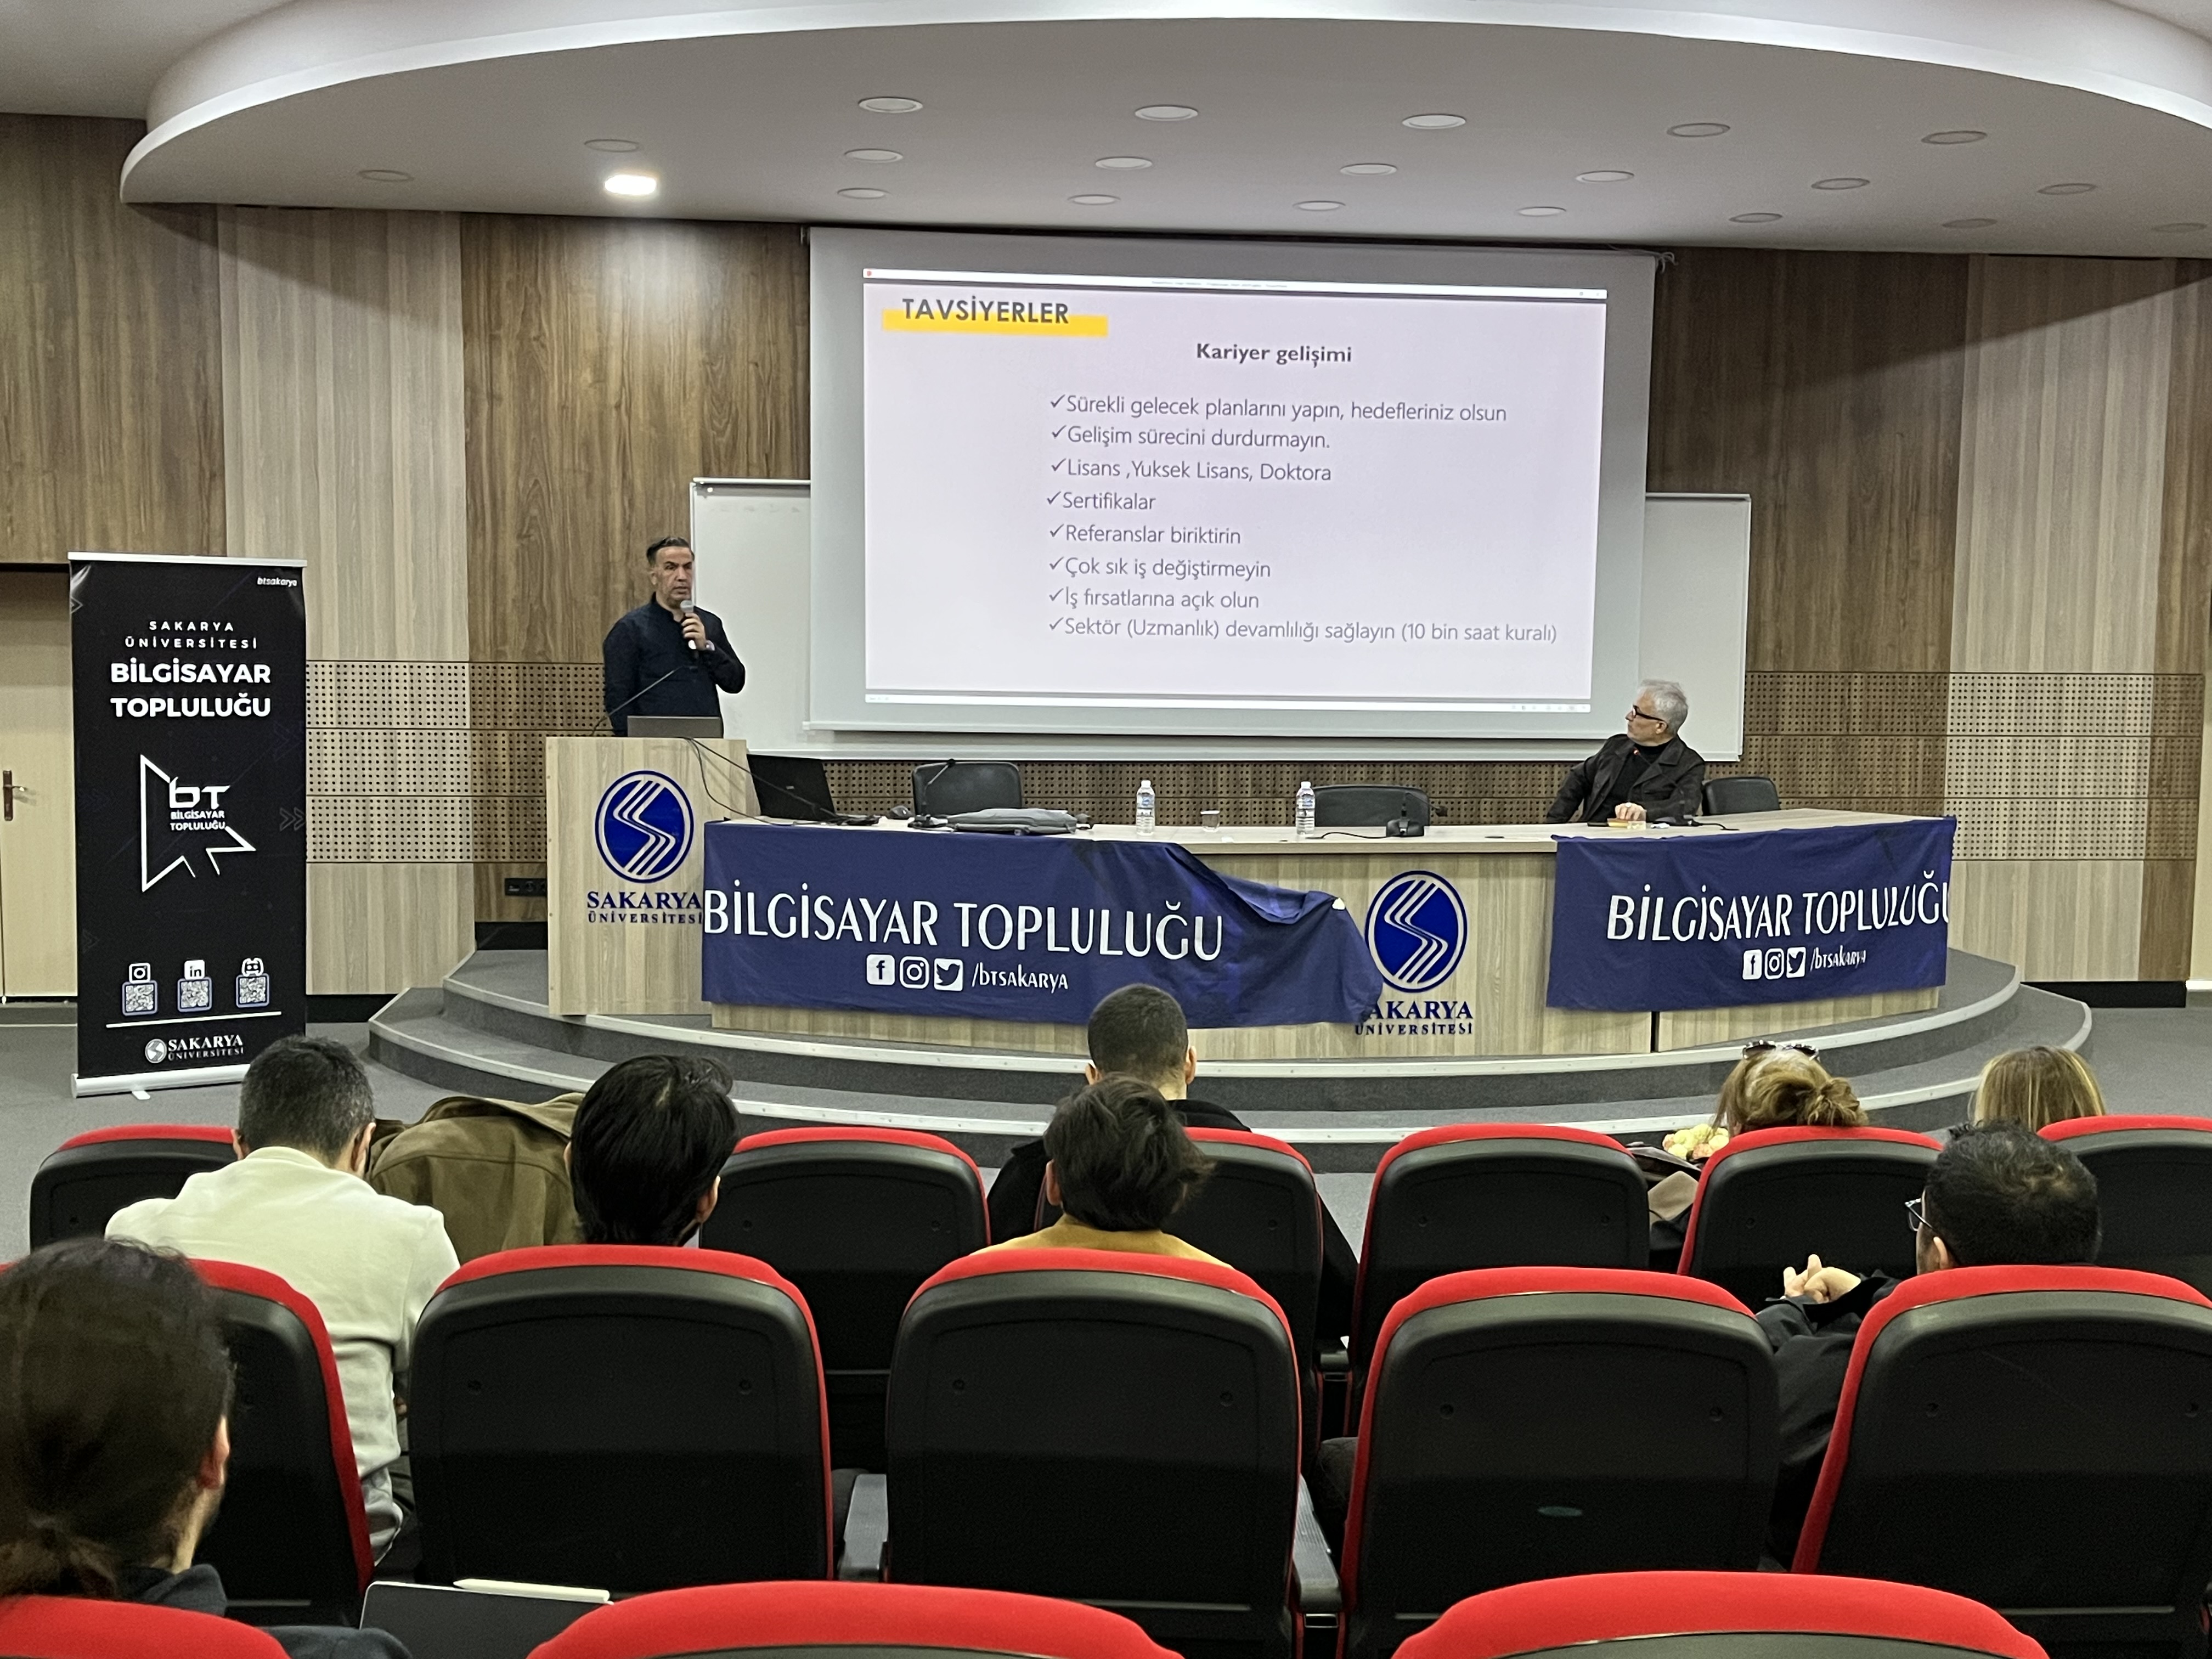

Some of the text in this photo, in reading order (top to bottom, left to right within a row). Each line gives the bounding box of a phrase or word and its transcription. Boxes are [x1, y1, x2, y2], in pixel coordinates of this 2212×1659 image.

[902, 295, 1069, 324] TAVSİYERLER
[1197, 343, 1351, 368] Kariyer gelişimi
[1066, 394, 1506, 422] Sürekli gelecek planlarını yapın, hedefleriniz olsun
[1068, 425, 1330, 453] Gelişim sürecini durdurmayın.
[1068, 459, 1331, 482] Lisans ,Yuksek Lisans, Doktora
[1063, 492, 1156, 510] Sertifikalar
[1066, 524, 1240, 544] Referanslar biriktirin
[1065, 557, 1271, 582] Çok sık iş değiştirmeyin
[257, 577, 297, 588] btsakarya
[1065, 586, 1259, 611] İş fırsatlarına açık olun
[149, 620, 234, 631] SAKARYA
[1065, 617, 1557, 644] Sektör (Uzmanlık) devamlılığı sağlayın (10 bin saat kuralı)
[125, 635, 257, 649] ÜNİVERSİTESİ
[111, 657, 270, 684] BİLGİSAYAR
[110, 692, 270, 718] TOPLULUĞU
[170, 809, 225, 820] BİLGİSAYAR
[170, 820, 225, 831] TOPLULUĞU
[587, 890, 702, 909] SAKARYA
[588, 911, 702, 924] ÜNİVERSİTESİ
[704, 879, 1223, 961] BİLGİSAYAR TOPLULUĞU
[1606, 884, 1793, 941] BİLGİSAYAR
[1369, 1000, 1474, 1020] AKARYA
[168, 1035, 243, 1052] SAKARYA
